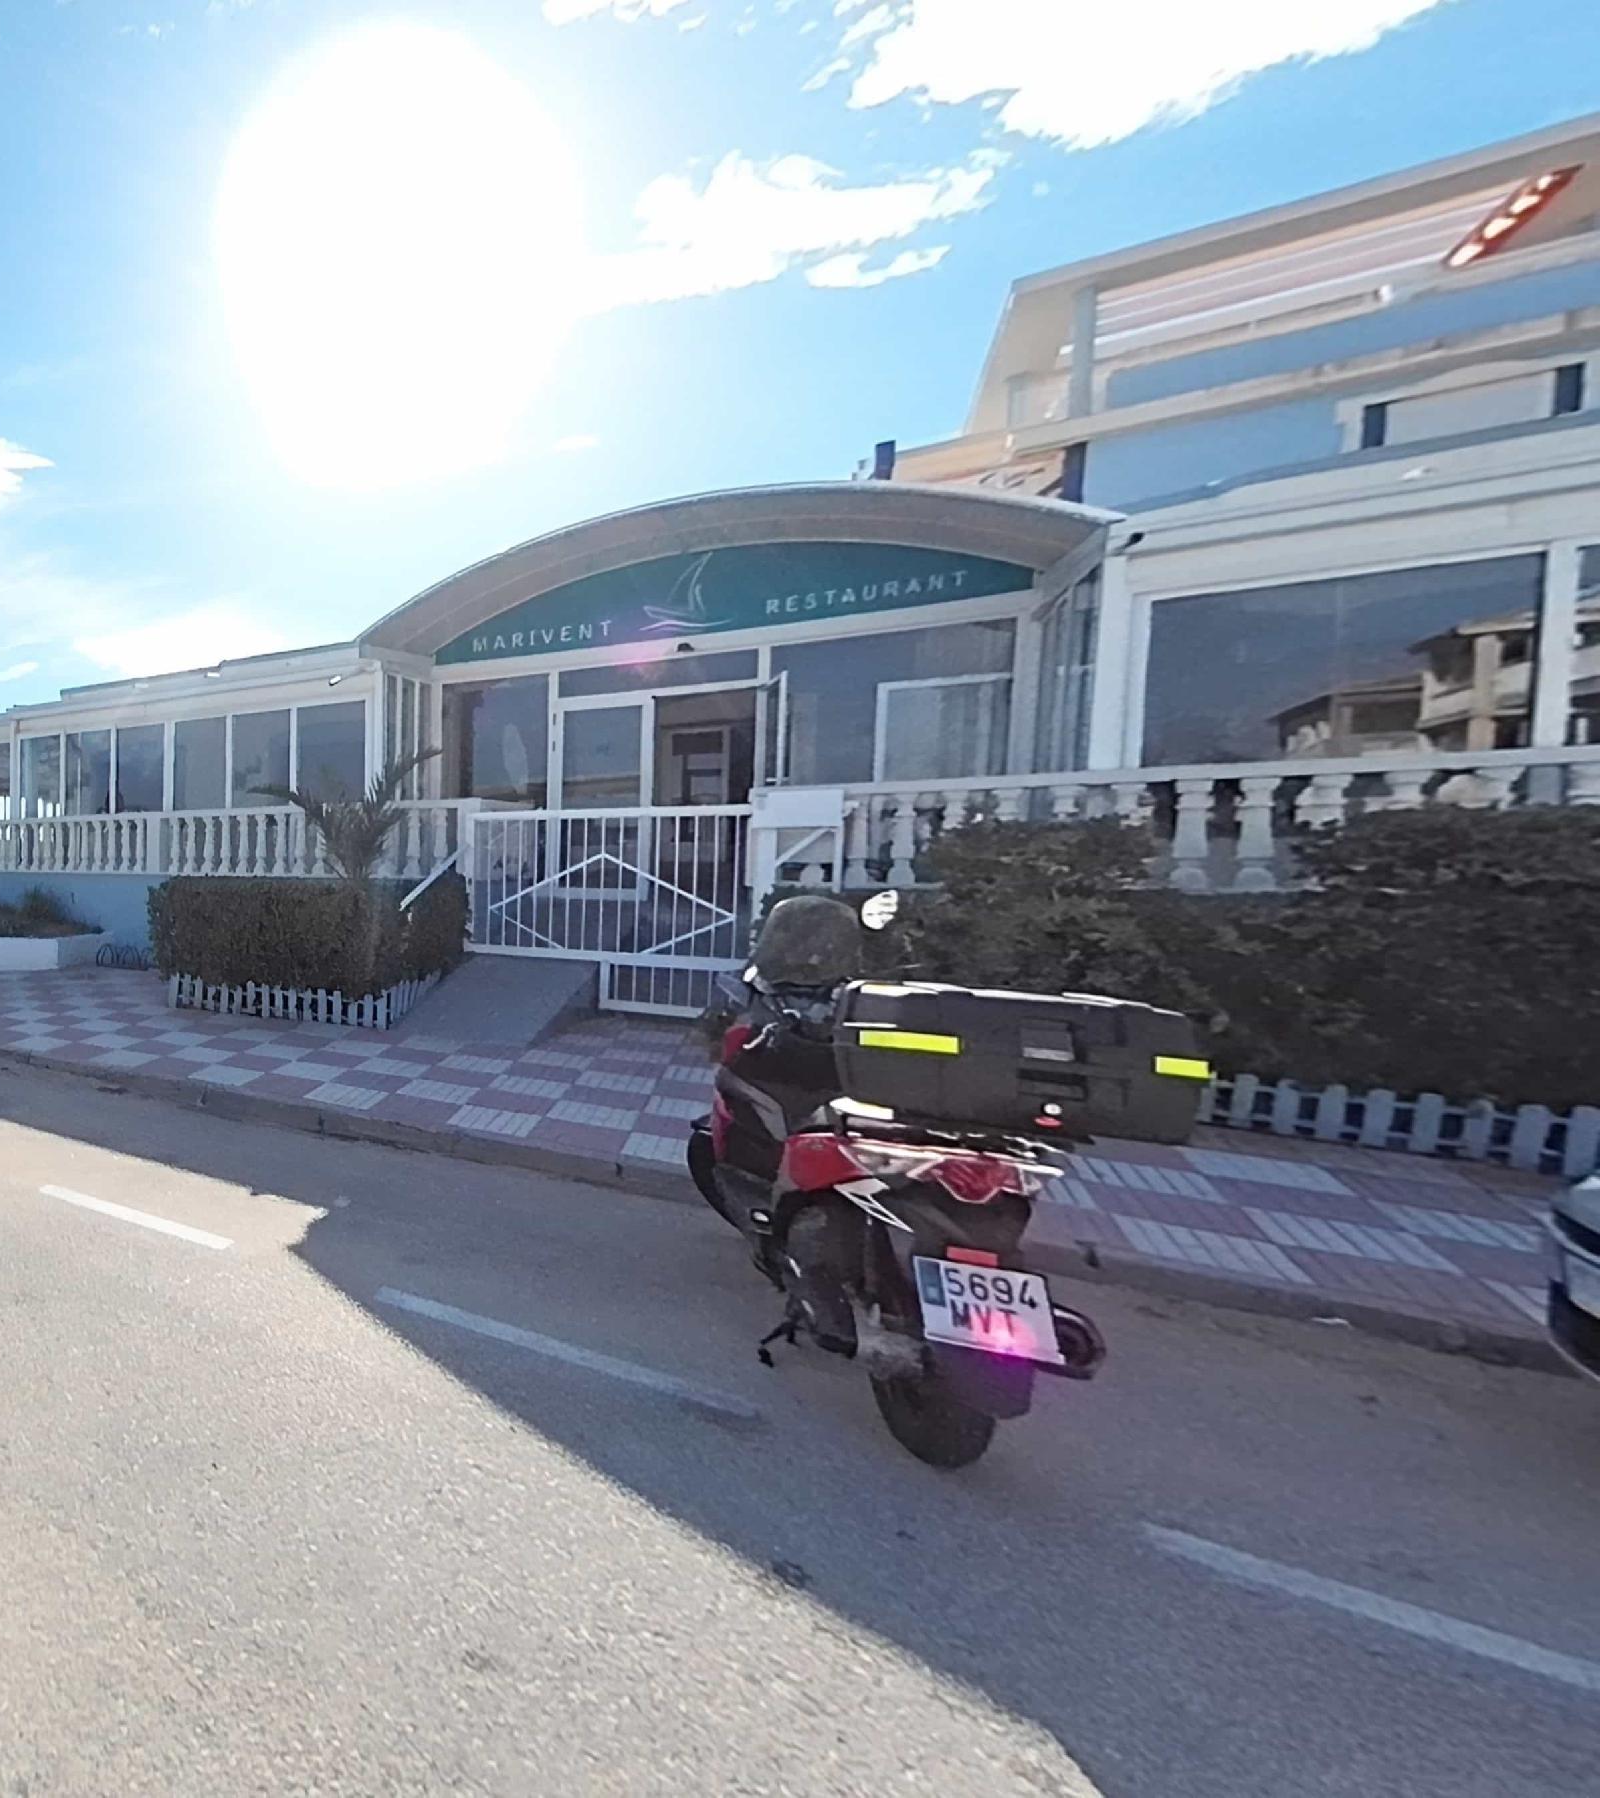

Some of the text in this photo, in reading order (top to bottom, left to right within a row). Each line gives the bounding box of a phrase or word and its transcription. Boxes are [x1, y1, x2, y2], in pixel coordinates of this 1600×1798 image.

[472, 569, 969, 653] MARIVENT RESTAURANT
[944, 1267, 1038, 1310] 5694
[950, 1298, 1018, 1338] MVT
